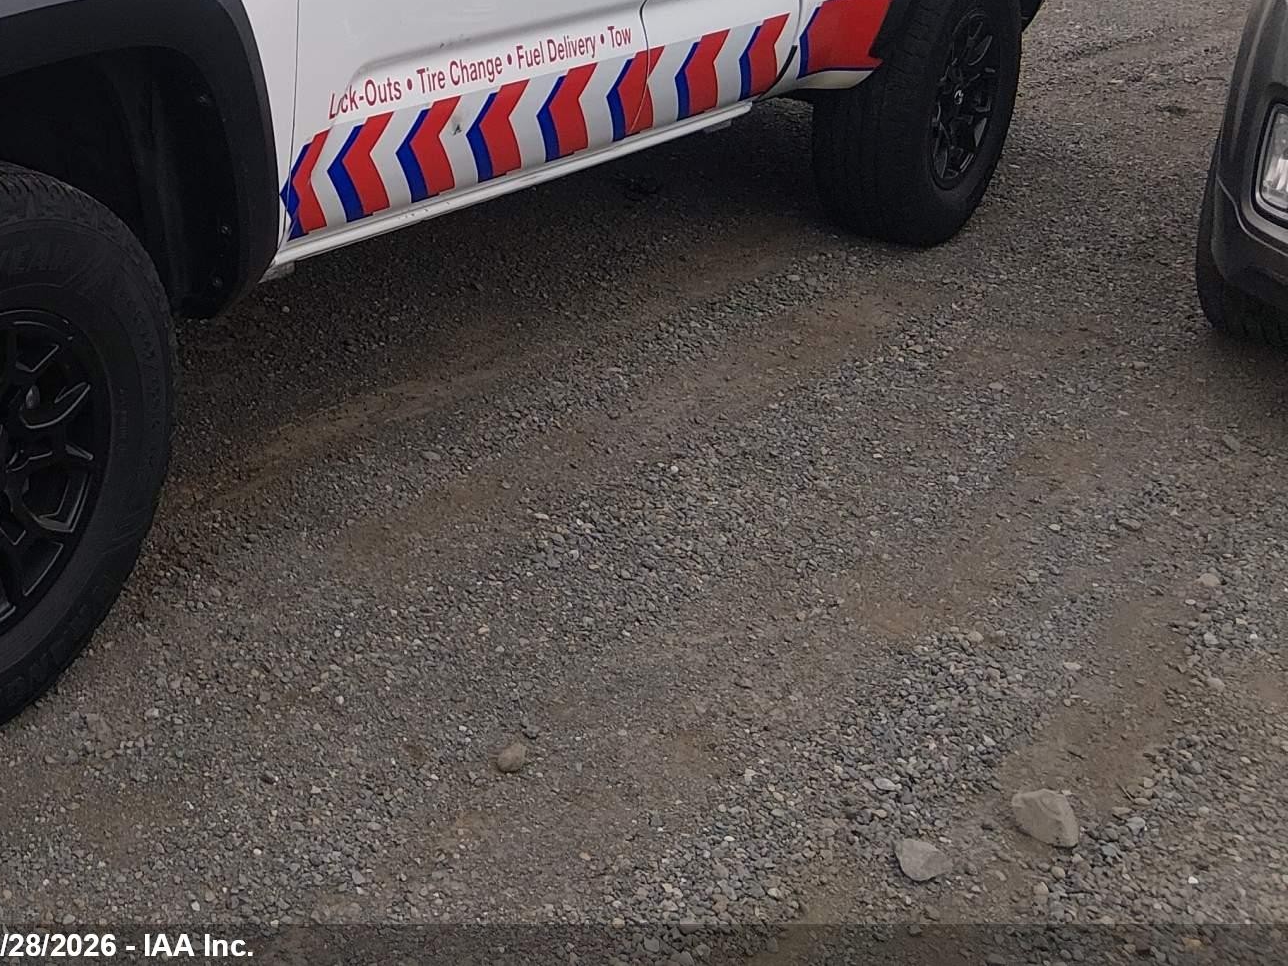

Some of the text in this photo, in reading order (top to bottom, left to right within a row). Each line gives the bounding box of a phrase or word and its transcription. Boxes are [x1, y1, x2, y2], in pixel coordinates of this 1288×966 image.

[416, 67, 446, 94] Tire
[450, 54, 503, 84] Change
[516, 44, 545, 69] Fuel
[548, 33, 597, 62] Delivery
[607, 25, 632, 47] Tow
